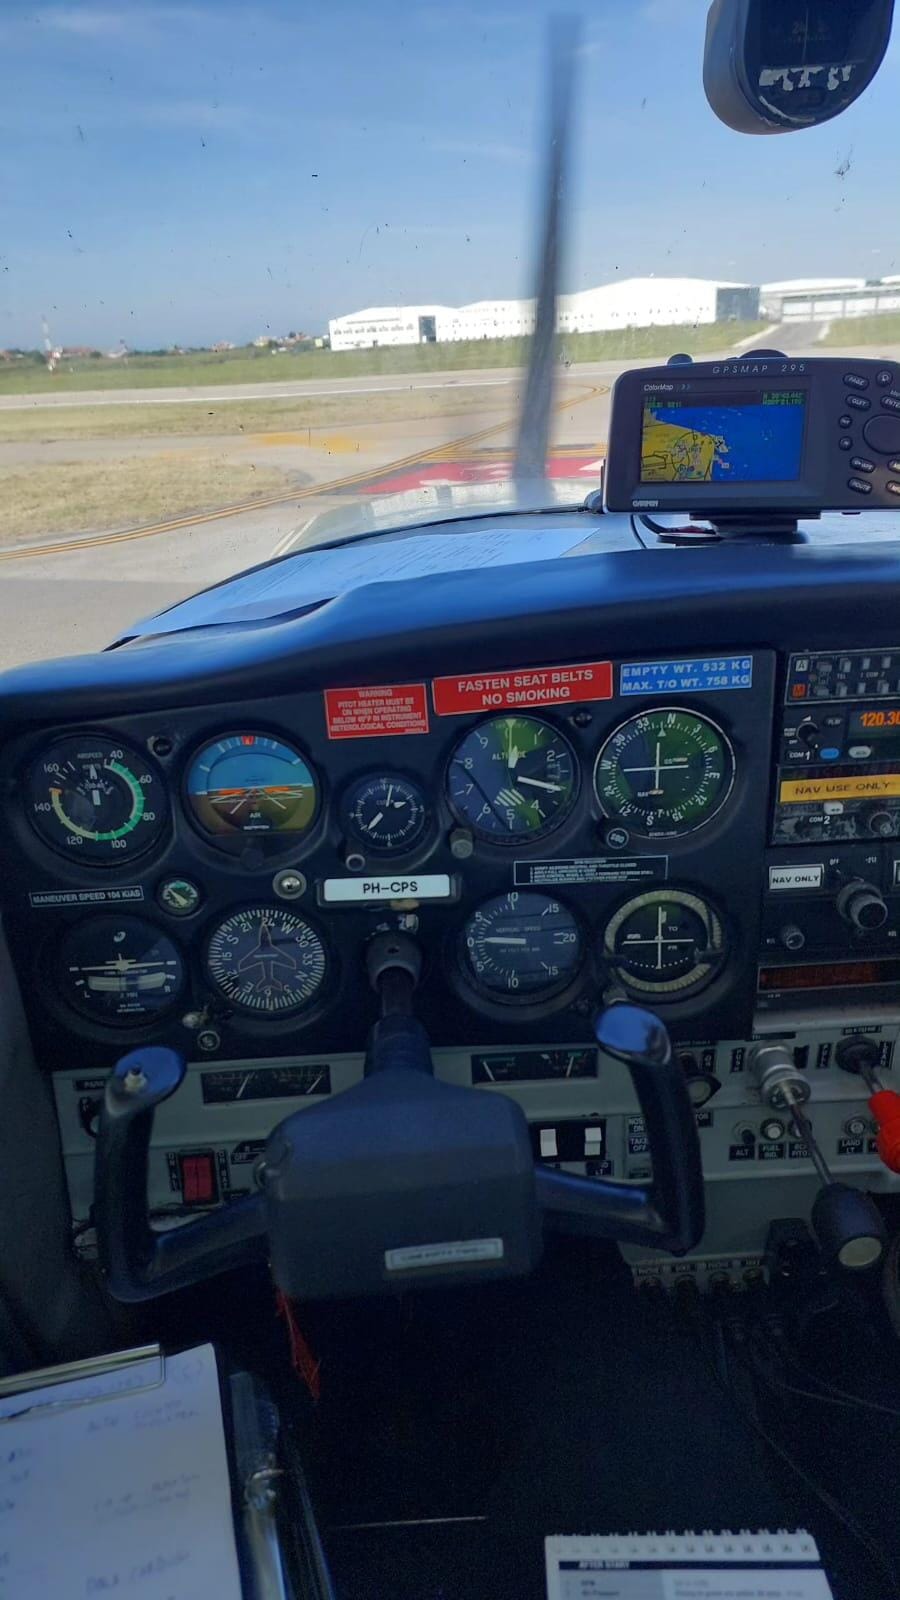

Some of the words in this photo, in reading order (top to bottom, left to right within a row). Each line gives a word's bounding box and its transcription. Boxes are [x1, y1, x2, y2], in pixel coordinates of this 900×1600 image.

[712, 364, 769, 374] GPSMAP
[782, 364, 806, 373] 295
[644, 384, 674, 392] ColorMap
[885, 398, 900, 408] ENTE
[623, 665, 669, 677] EMPTY
[673, 663, 697, 673] WT.
[731, 660, 750, 670] KG
[457, 677, 510, 692] FASTEN
[513, 673, 548, 688] SEAT
[551, 669, 593, 683] BELTS
[622, 681, 653, 691] MAX.
[656, 679, 677, 689] T/O
[680, 678, 703, 687] WT.
[707, 676, 728, 686] 758
[731, 674, 750, 684] KG
[482, 693, 502, 706] NO
[506, 687, 570, 703] SMOKING
[636, 717, 649, 729] 33
[667, 713, 677, 724] N
[479, 736, 489, 749] 9
[110, 750, 123, 759] 40
[546, 750, 556, 762] 2
[805, 751, 811, 760] 1
[44, 763, 60, 773] 160
[464, 757, 474, 770] 8
[140, 775, 153, 784] 60
[465, 783, 474, 795] 7
[795, 786, 821, 795] NAV
[826, 784, 848, 792] USE
[856, 782, 891, 790] ONLY
[35, 802, 51, 812] 140
[482, 803, 492, 815] 6
[530, 800, 540, 810] 4
[143, 812, 156, 821] 80
[506, 809, 516, 821] 5
[823, 816, 831, 825] 2
[67, 836, 83, 845] 120
[111, 839, 127, 849] 100
[363, 881, 418, 894] PH-CPS
[32, 893, 78, 904] MANEUVER
[79, 891, 106, 901] SPEED
[507, 892, 519, 902] 10
[548, 903, 560, 913] 15
[262, 917, 275, 926] 24
[475, 912, 483, 922] 5
[281, 921, 294, 934] W
[227, 934, 239, 945] S
[467, 937, 474, 947] 0
[562, 933, 576, 943] 20
[476, 961, 484, 972] 5
[548, 966, 559, 976] 15
[508, 977, 519, 988] 10
[841, 1139, 860, 1147] LAND
